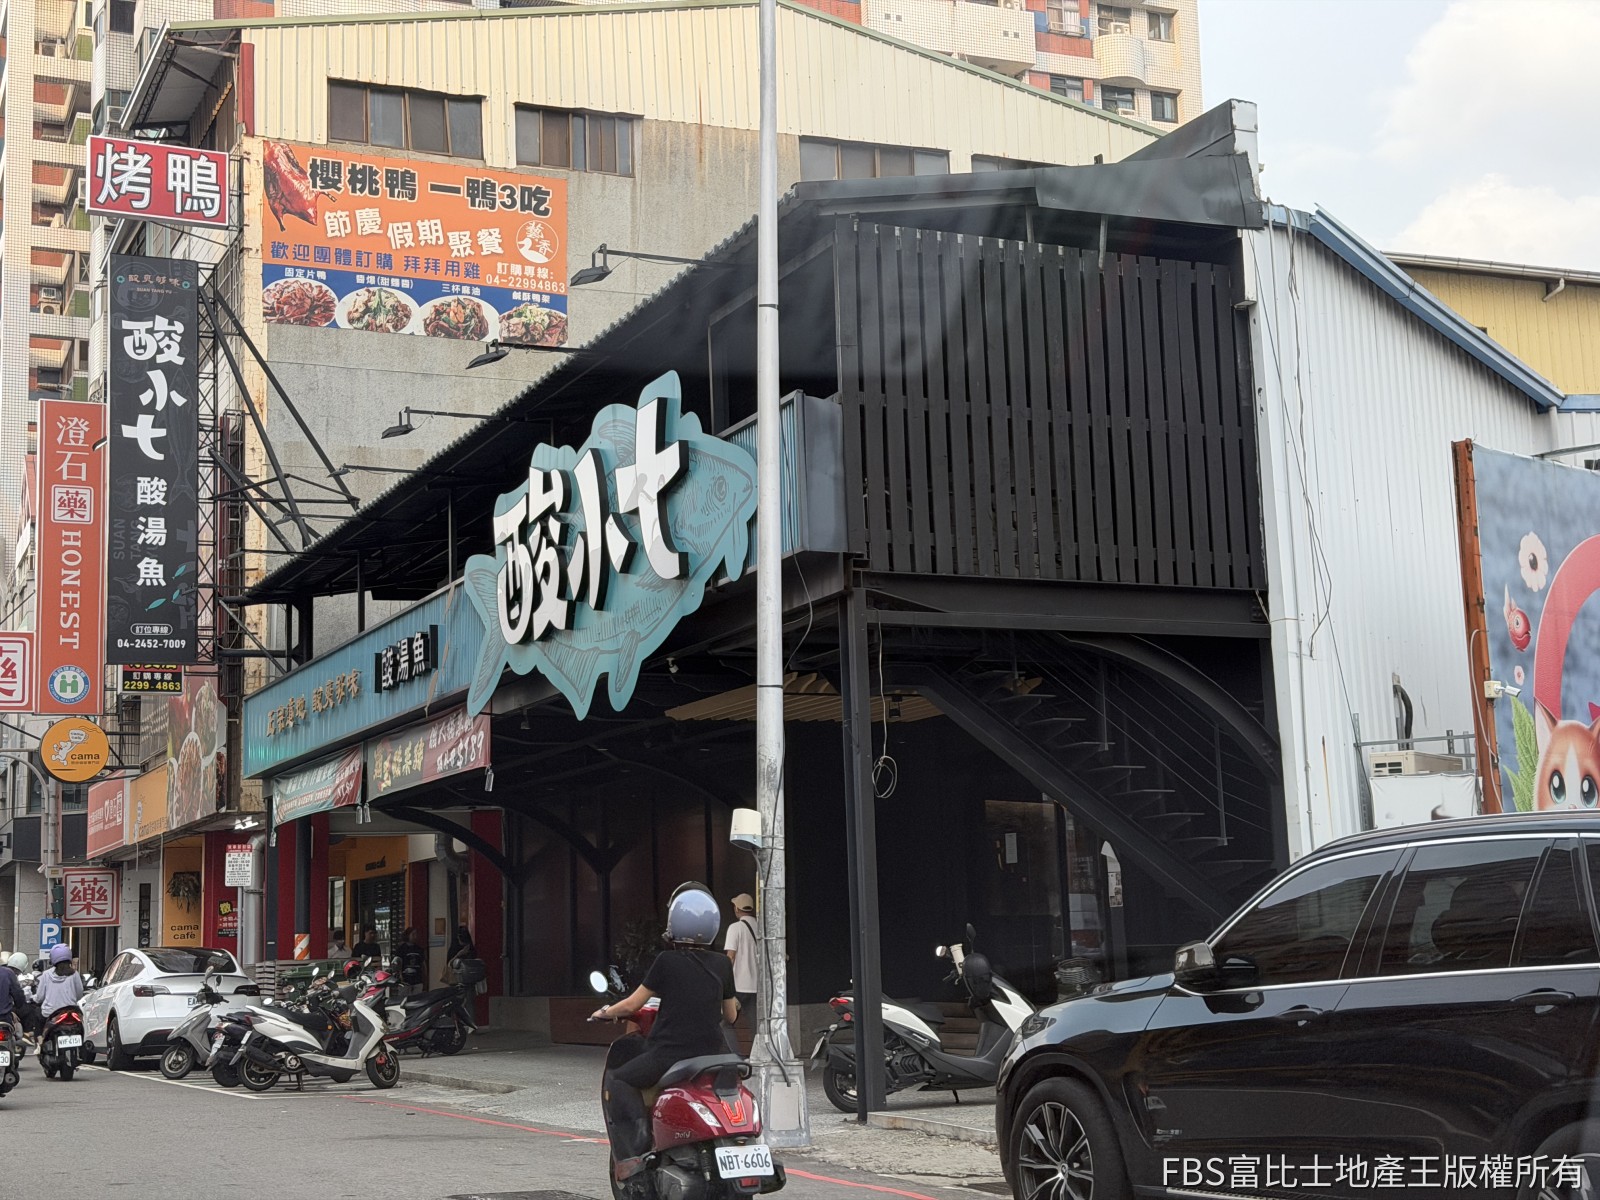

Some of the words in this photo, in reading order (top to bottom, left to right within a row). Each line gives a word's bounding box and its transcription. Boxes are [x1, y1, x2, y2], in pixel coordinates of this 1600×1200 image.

[95, 142, 221, 218] 烤鴨
[308, 156, 418, 202] 櫻桃鴨
[428, 176, 552, 217] 一鴨3吃
[324, 207, 383, 238] 節慶
[387, 218, 444, 250] 假期
[447, 228, 504, 258] 聚餐
[270, 241, 394, 271] 歡迎團體訂購
[404, 255, 480, 280] 拜拜用雞
[441, 283, 481, 296] 三杯麻油
[485, 274, 566, 293] 04-22994863
[121, 314, 188, 461] 酸小七
[55, 415, 91, 481] 澄石
[57, 490, 88, 519] 藥
[493, 397, 688, 645] 酸小七
[113, 519, 125, 560] SUAN
[136, 476, 168, 587] 酸湯魚
[60, 529, 82, 650] HONEST
[117, 639, 186, 649] 04-2452-7009
[135, 625, 169, 634] 訂位專線
[381, 630, 431, 691] 酸湯魚
[70, 752, 100, 761] cama
[69, 877, 109, 916] 藥
[42, 923, 60, 945] P
[170, 923, 199, 931] cama
[173, 931, 196, 940] café
[719, 1152, 771, 1172] NBT-6606
